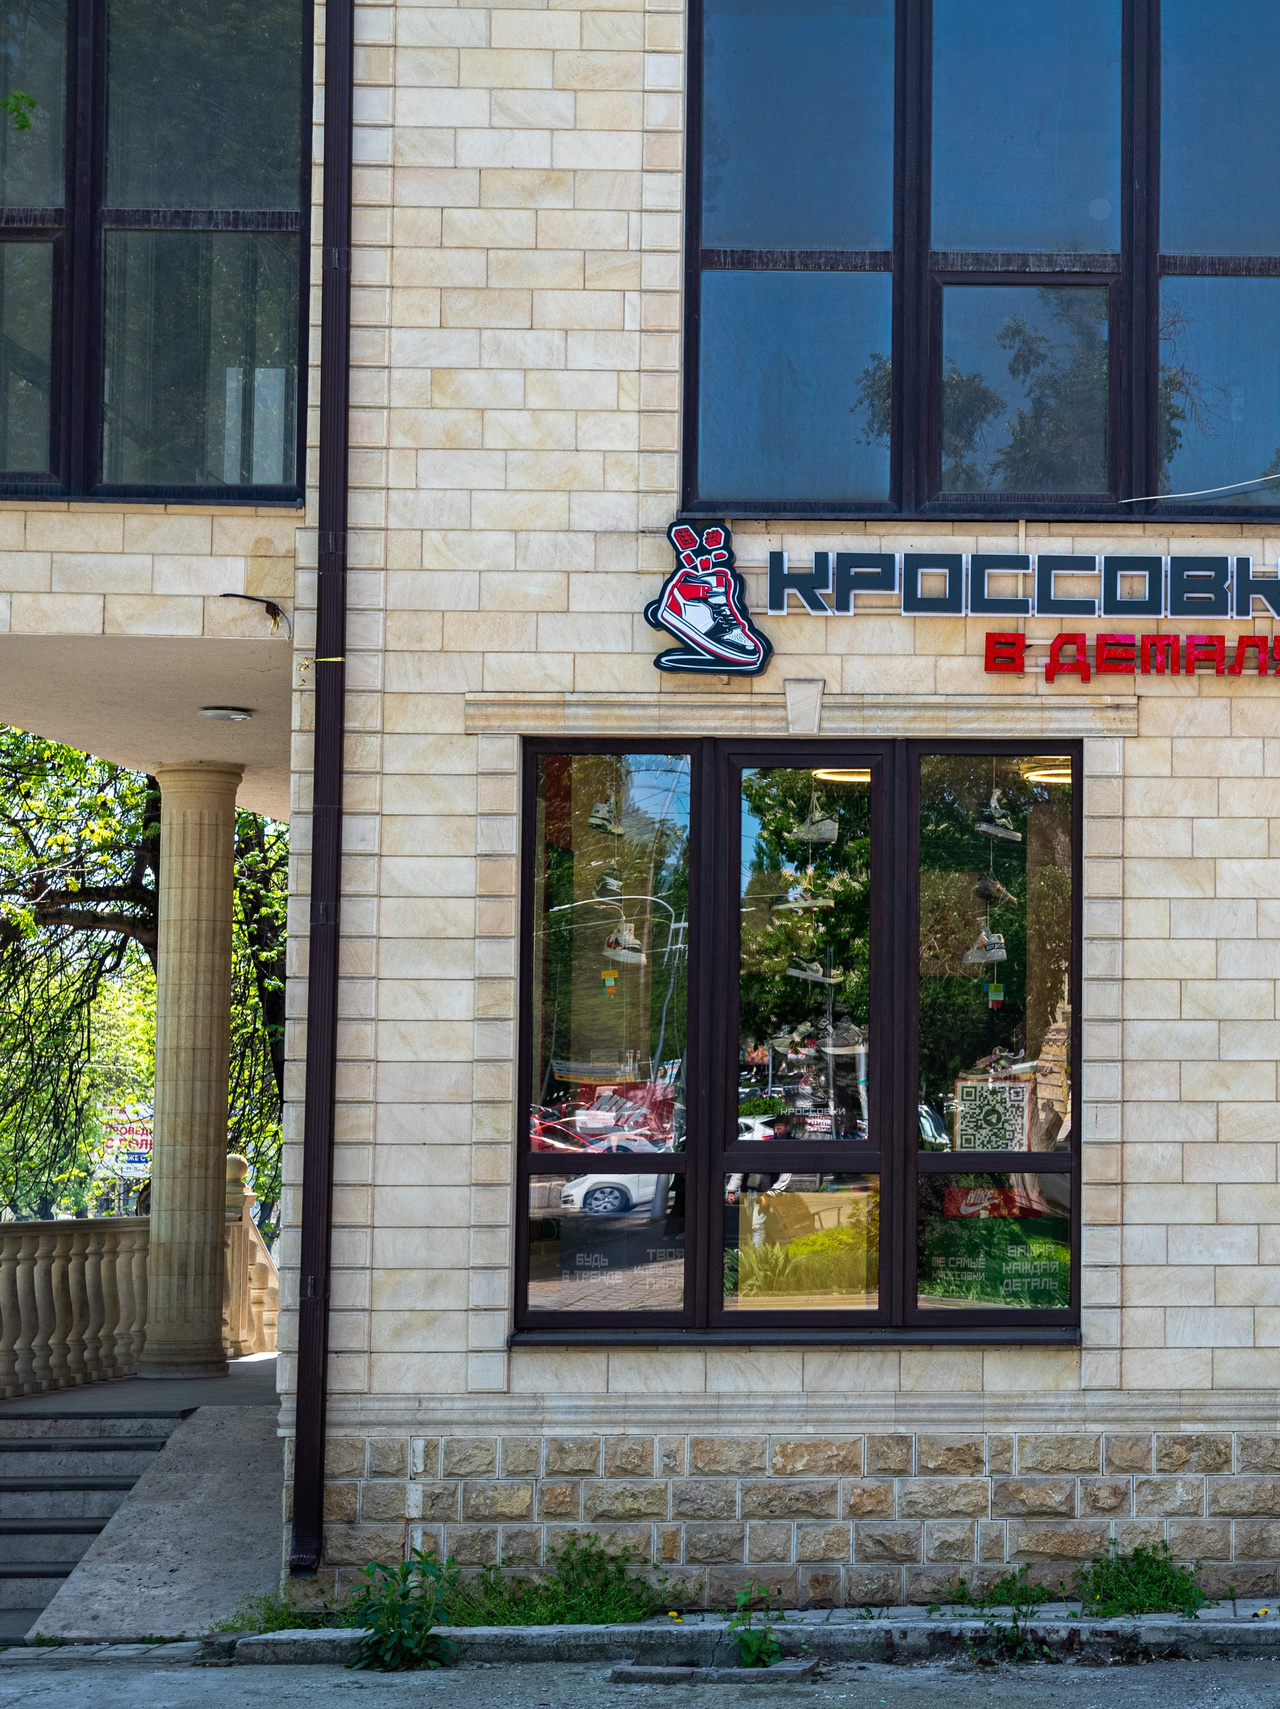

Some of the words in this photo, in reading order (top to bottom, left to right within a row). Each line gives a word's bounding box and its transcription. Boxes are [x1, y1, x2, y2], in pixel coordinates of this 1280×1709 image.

[984, 632, 1026, 675] В
[780, 1107, 846, 1116] КРОССОВКИ
[966, 1189, 994, 1204] NIKE
[576, 1253, 609, 1268] БУДЬ
[646, 1248, 684, 1261] ТВОЯ
[1002, 1260, 1059, 1275] КАЖДАЯ
[562, 1270, 570, 1282] В
[574, 1270, 623, 1285] ТРЕНДЕ
[1002, 1277, 1059, 1293] ДЕТАЛЬ
